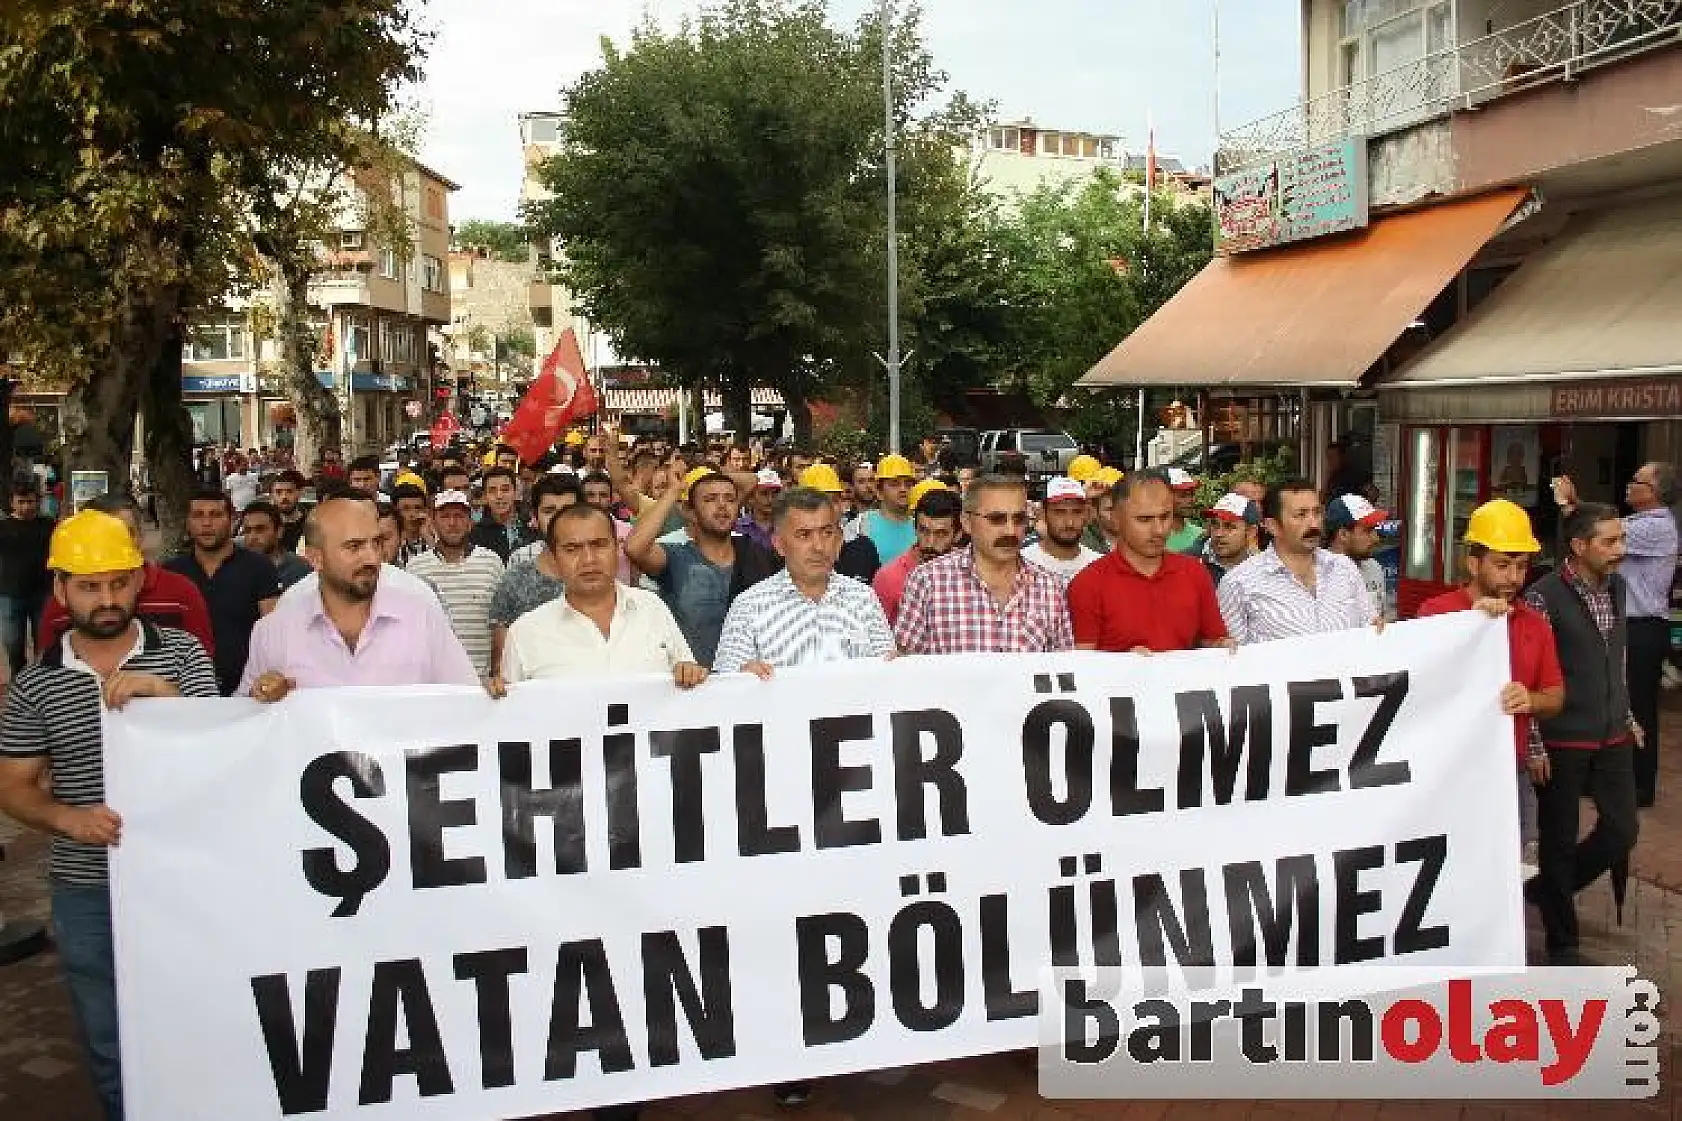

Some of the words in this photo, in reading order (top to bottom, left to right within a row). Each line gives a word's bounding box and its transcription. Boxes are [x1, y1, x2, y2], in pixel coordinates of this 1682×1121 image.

[300, 703, 972, 918] ŞEHİTLER
[1021, 670, 1412, 826] ÖLMEZ
[250, 924, 737, 1117] VATAN
[796, 833, 1450, 1048] BÖLÜNMEZ
